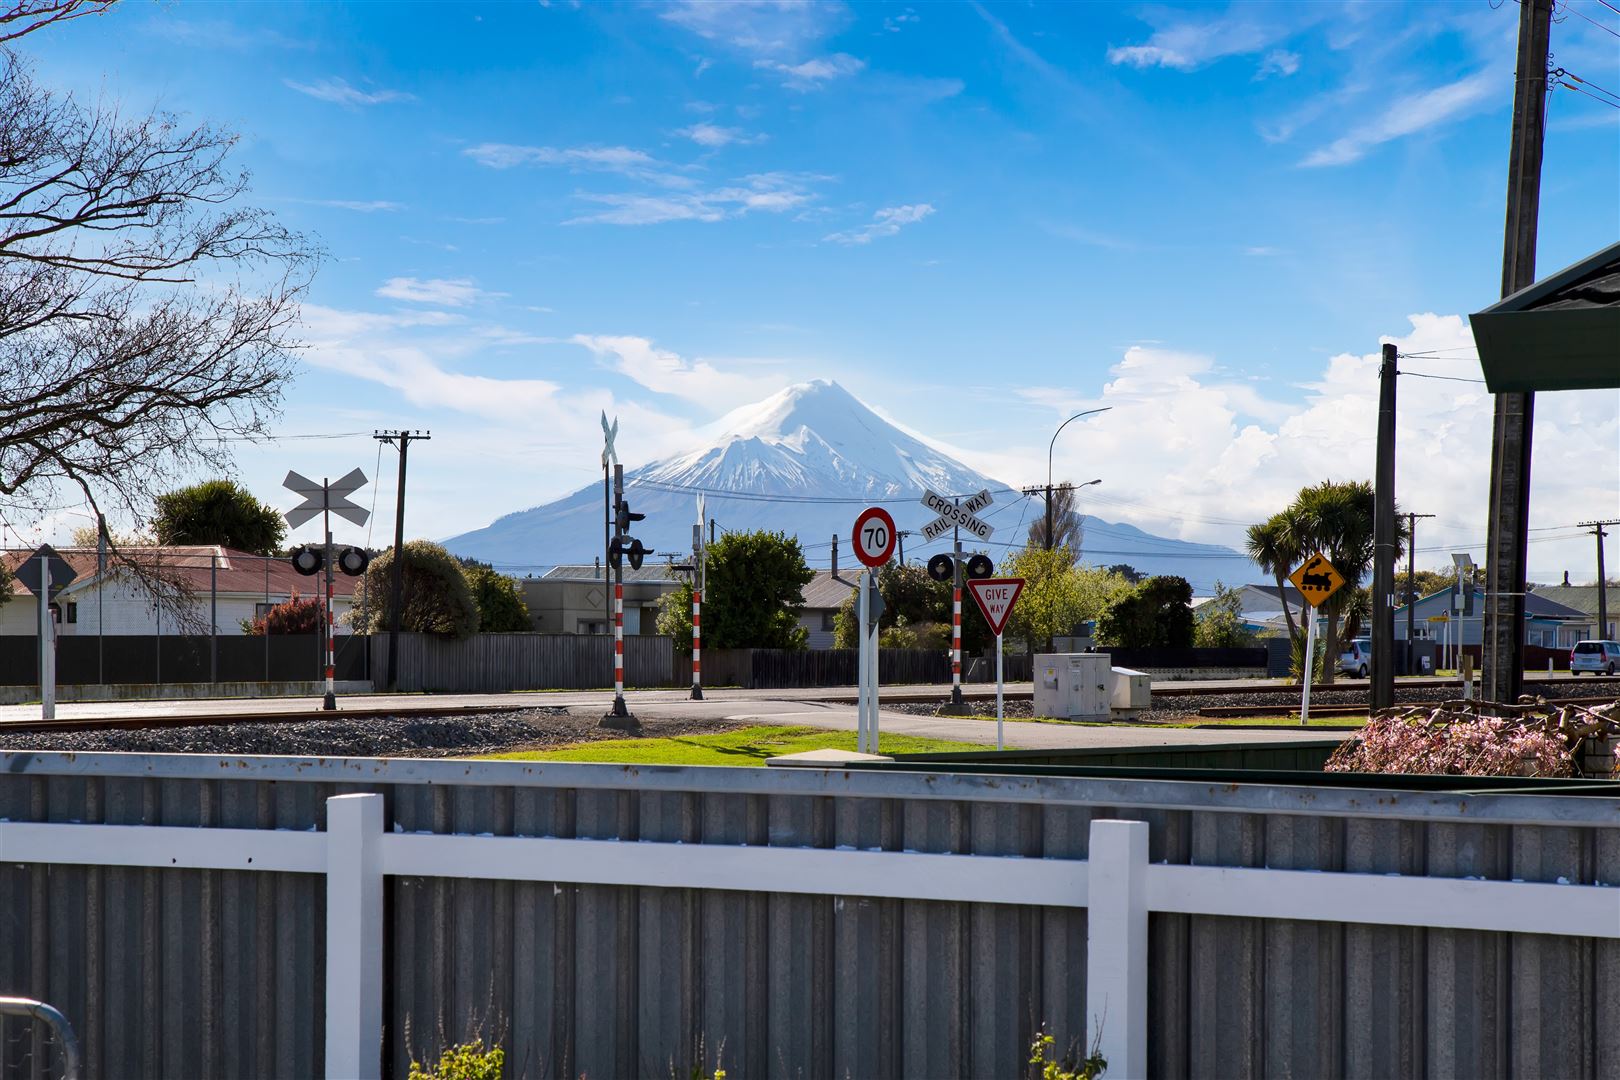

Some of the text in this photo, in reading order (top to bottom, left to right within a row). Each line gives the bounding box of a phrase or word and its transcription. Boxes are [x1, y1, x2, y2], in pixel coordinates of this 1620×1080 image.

[925, 493, 988, 538] RAIL WAY
[927, 495, 988, 536] CROSSING
[864, 527, 886, 550] 70
[985, 588, 1009, 601] GIVE
[990, 604, 1005, 614] WAY
